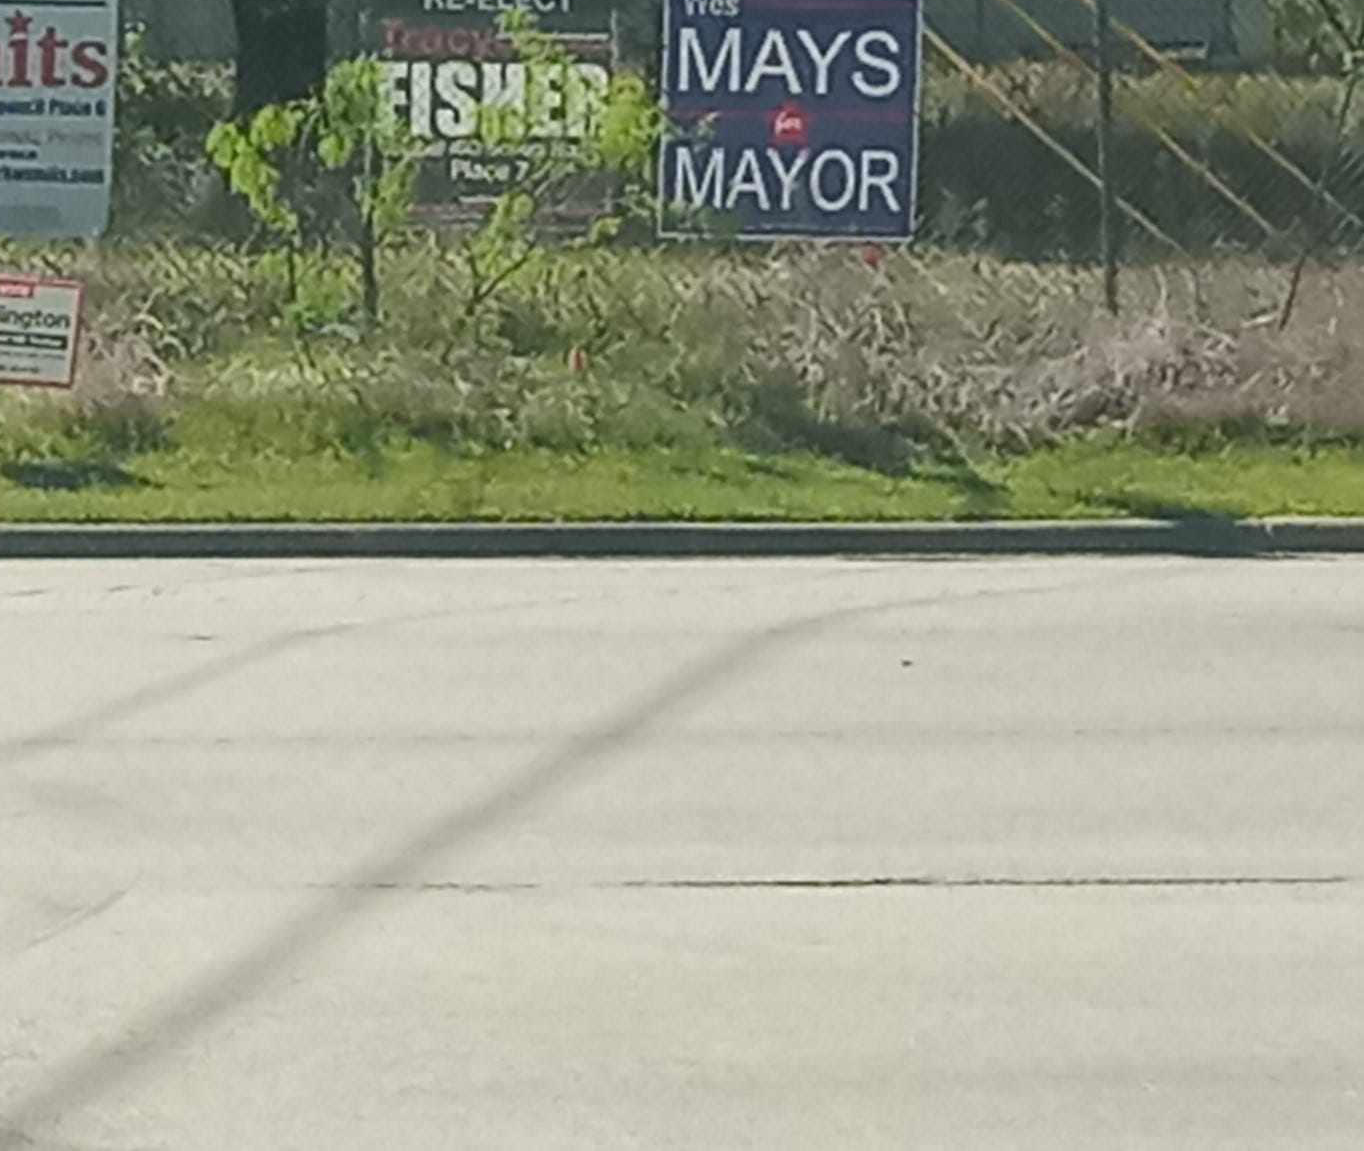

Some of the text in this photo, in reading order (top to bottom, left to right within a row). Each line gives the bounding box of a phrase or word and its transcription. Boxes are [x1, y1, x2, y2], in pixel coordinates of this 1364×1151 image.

[380, 17, 494, 62] Tracy
[676, 26, 902, 97] MAYS
[48, 97, 92, 117] Place
[514, 160, 530, 182] 7
[673, 146, 902, 213] MAYOR
